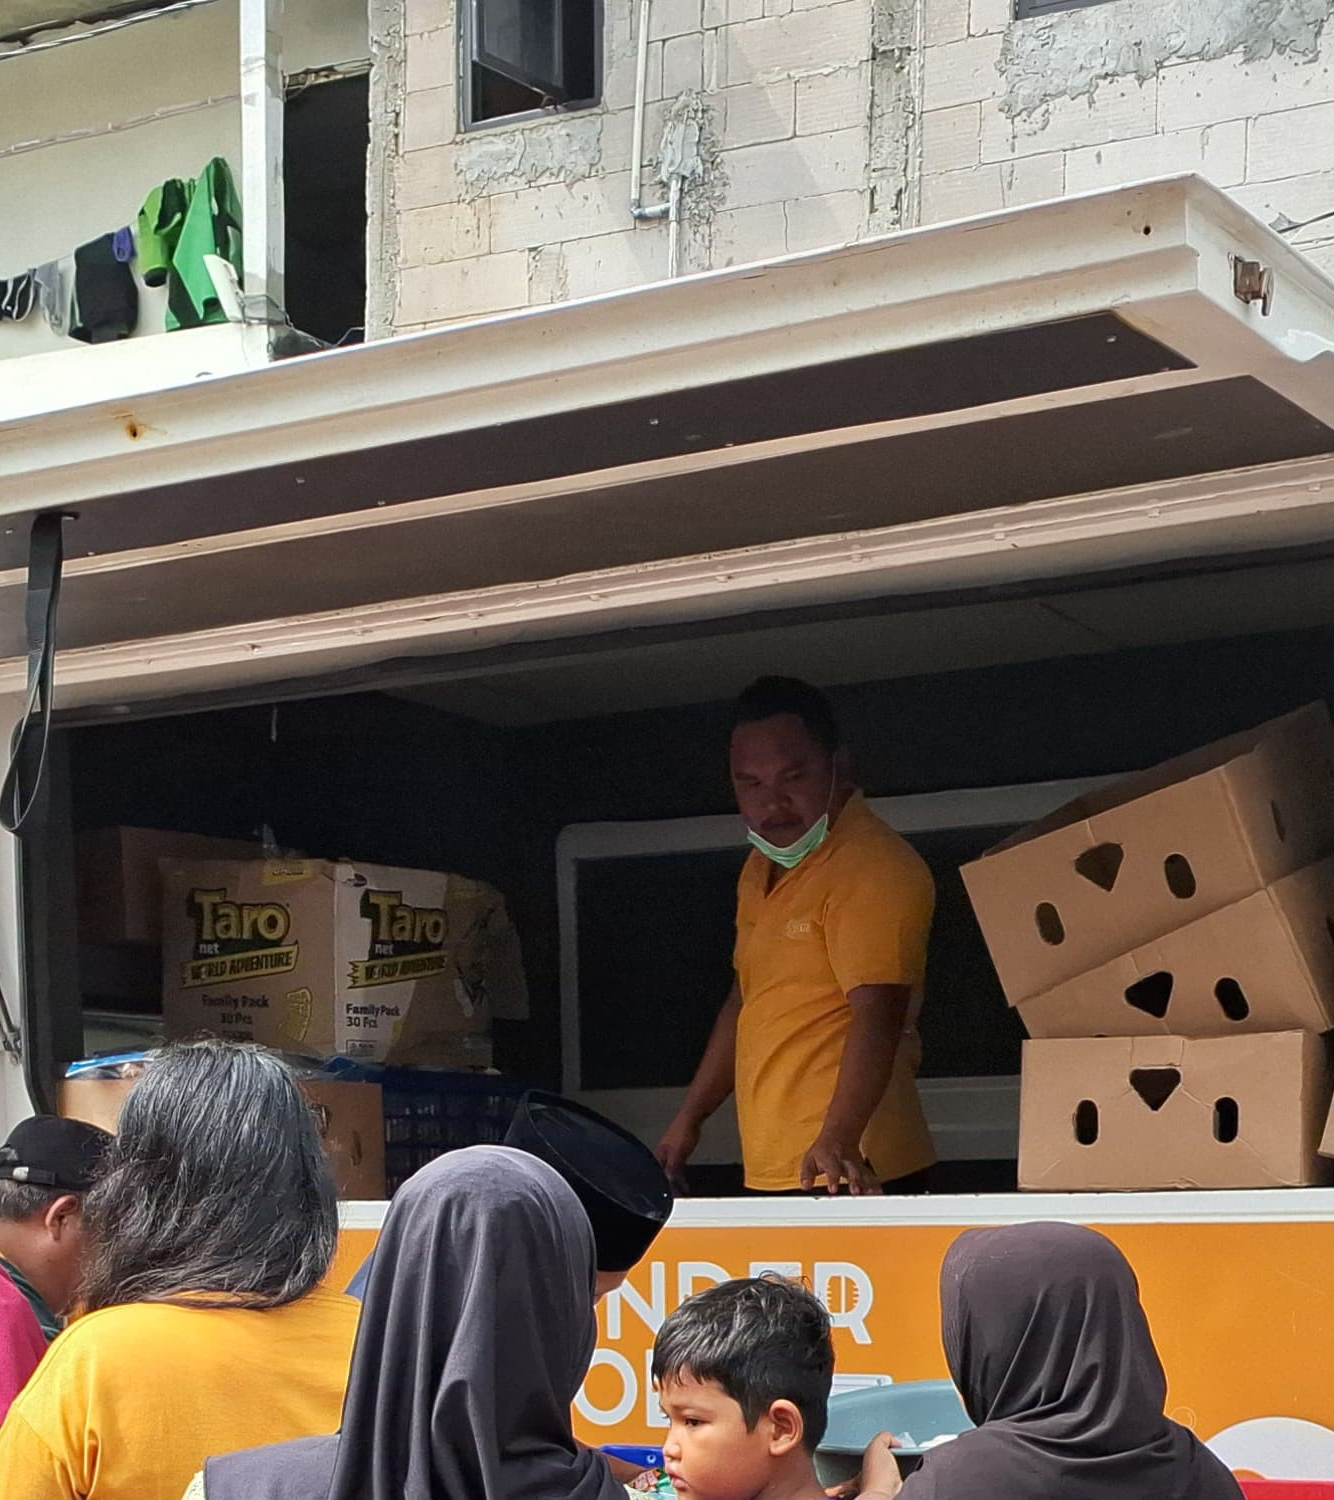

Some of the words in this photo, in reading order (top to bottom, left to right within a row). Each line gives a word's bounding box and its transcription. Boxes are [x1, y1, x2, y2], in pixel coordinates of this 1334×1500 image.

[192, 890, 289, 941] Taro
[367, 891, 446, 944] Taro
[346, 1003, 380, 1018] Family
